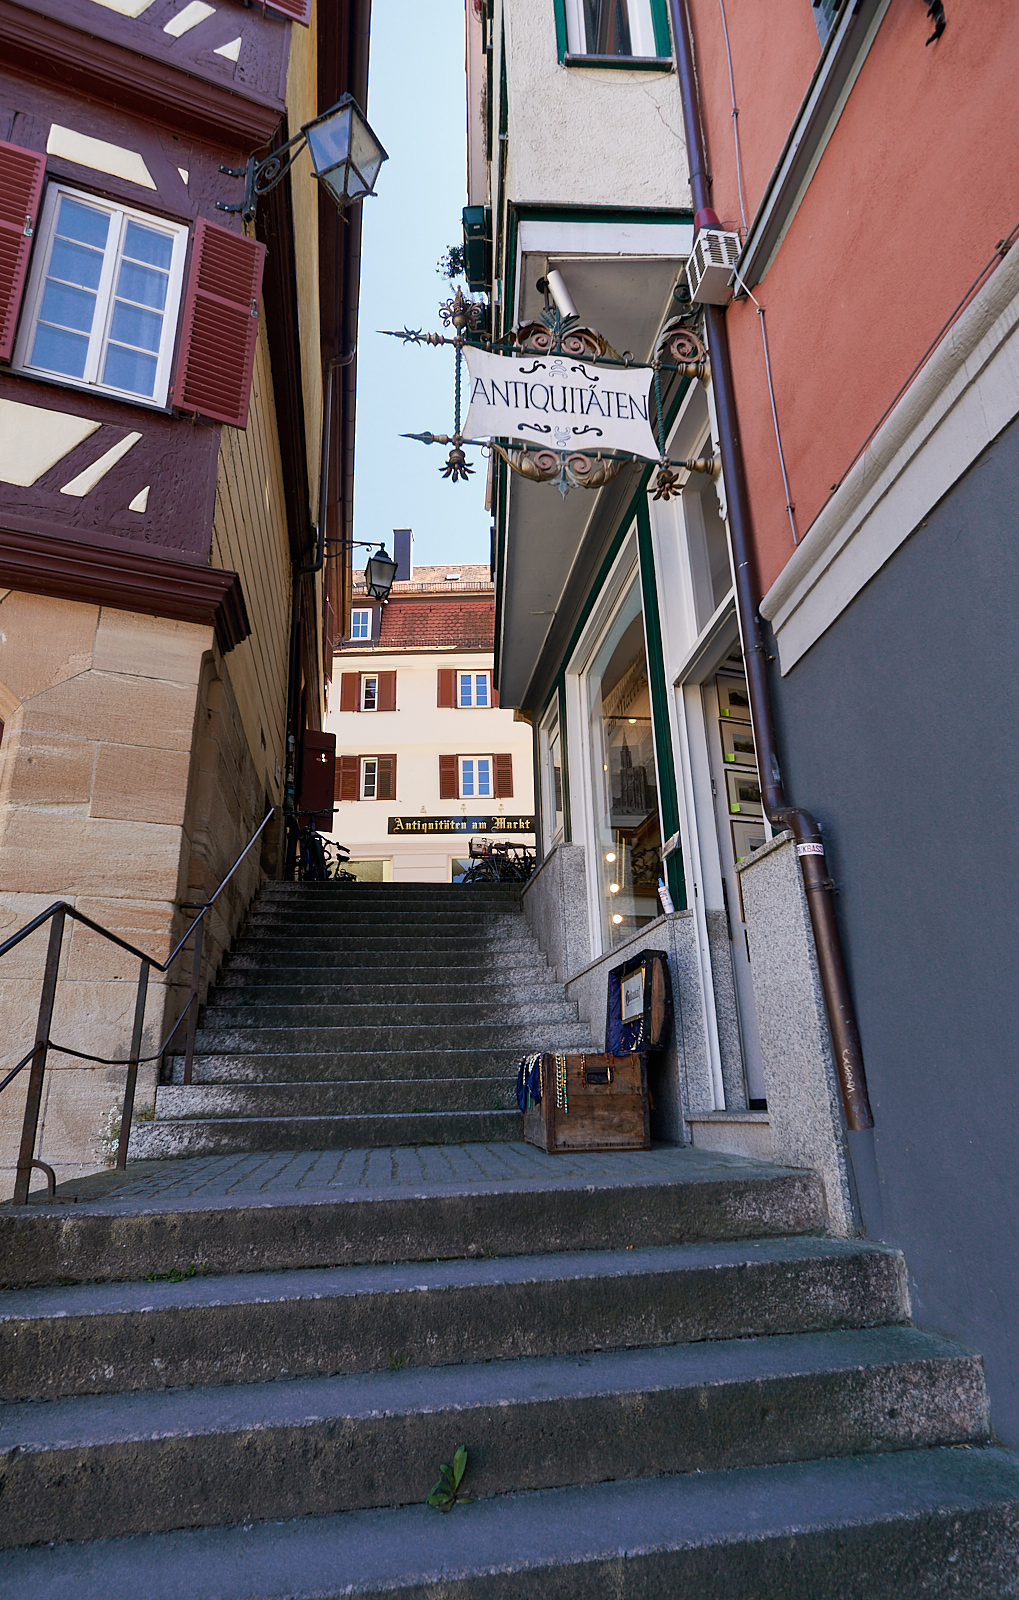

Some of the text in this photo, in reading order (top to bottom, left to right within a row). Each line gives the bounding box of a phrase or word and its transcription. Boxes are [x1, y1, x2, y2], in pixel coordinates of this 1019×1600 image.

[471, 377, 648, 421] ANTIQUITÄTEN
[393, 816, 531, 833] Antiquitäten am Markt
